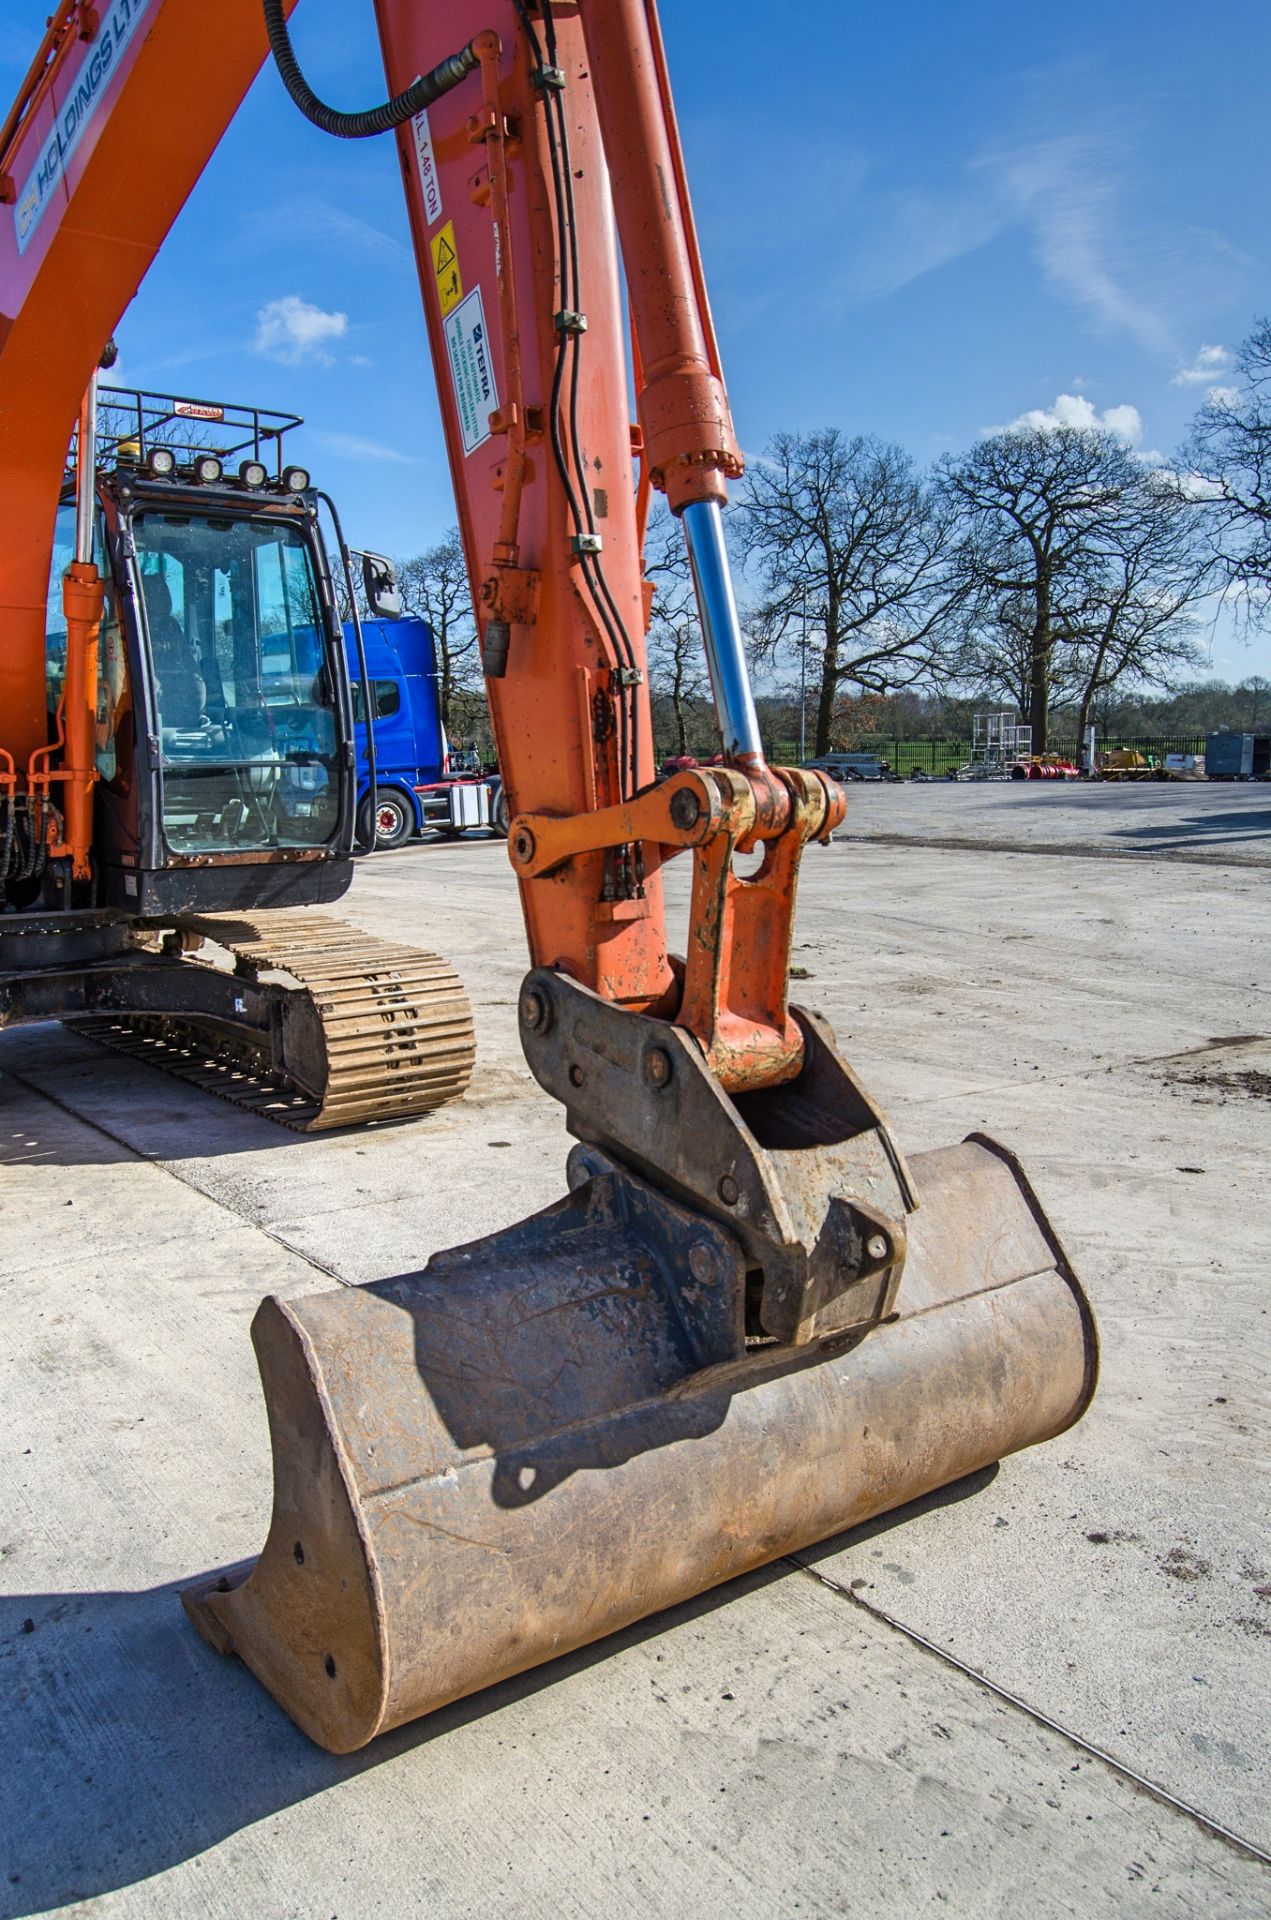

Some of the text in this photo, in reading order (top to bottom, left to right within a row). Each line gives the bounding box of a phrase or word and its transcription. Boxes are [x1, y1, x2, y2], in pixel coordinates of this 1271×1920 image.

[37, 30, 112, 196] HOLDINGS
[113, 0, 142, 42] LT
[426, 180, 438, 216] TON
[451, 336, 457, 349] NO
[453, 349, 461, 376] SAFETY
[455, 316, 479, 438] DOUBLE LOCKING COUPLER FITTED
[466, 338, 481, 404] FULLY AUTOMATIC
[476, 343, 490, 401] TEFRA
[460, 391, 470, 431] REQUIRED
